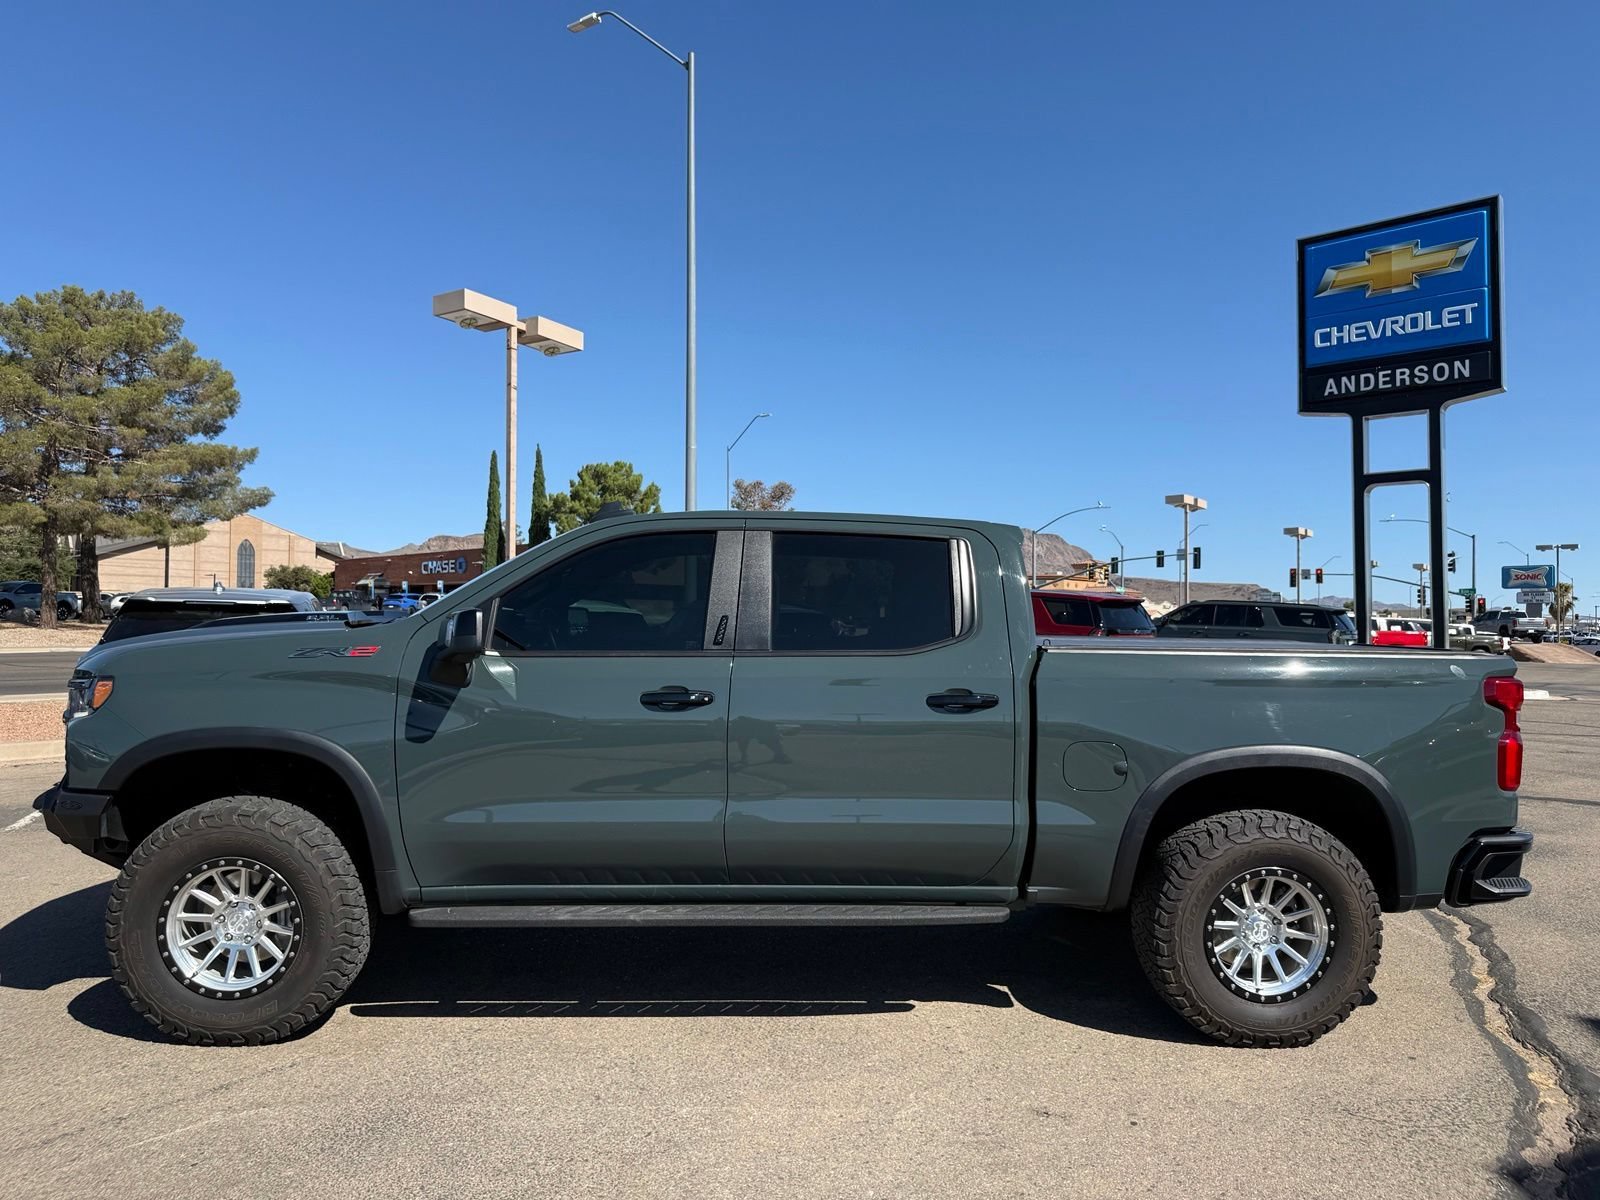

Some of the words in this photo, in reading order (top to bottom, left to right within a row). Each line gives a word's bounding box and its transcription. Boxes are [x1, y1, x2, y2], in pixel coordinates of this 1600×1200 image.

[1314, 303, 1478, 348] CHEVROLET
[1324, 359, 1471, 396] ANDERSON
[421, 560, 456, 575] CHASE
[1513, 573, 1542, 581] SONIC
